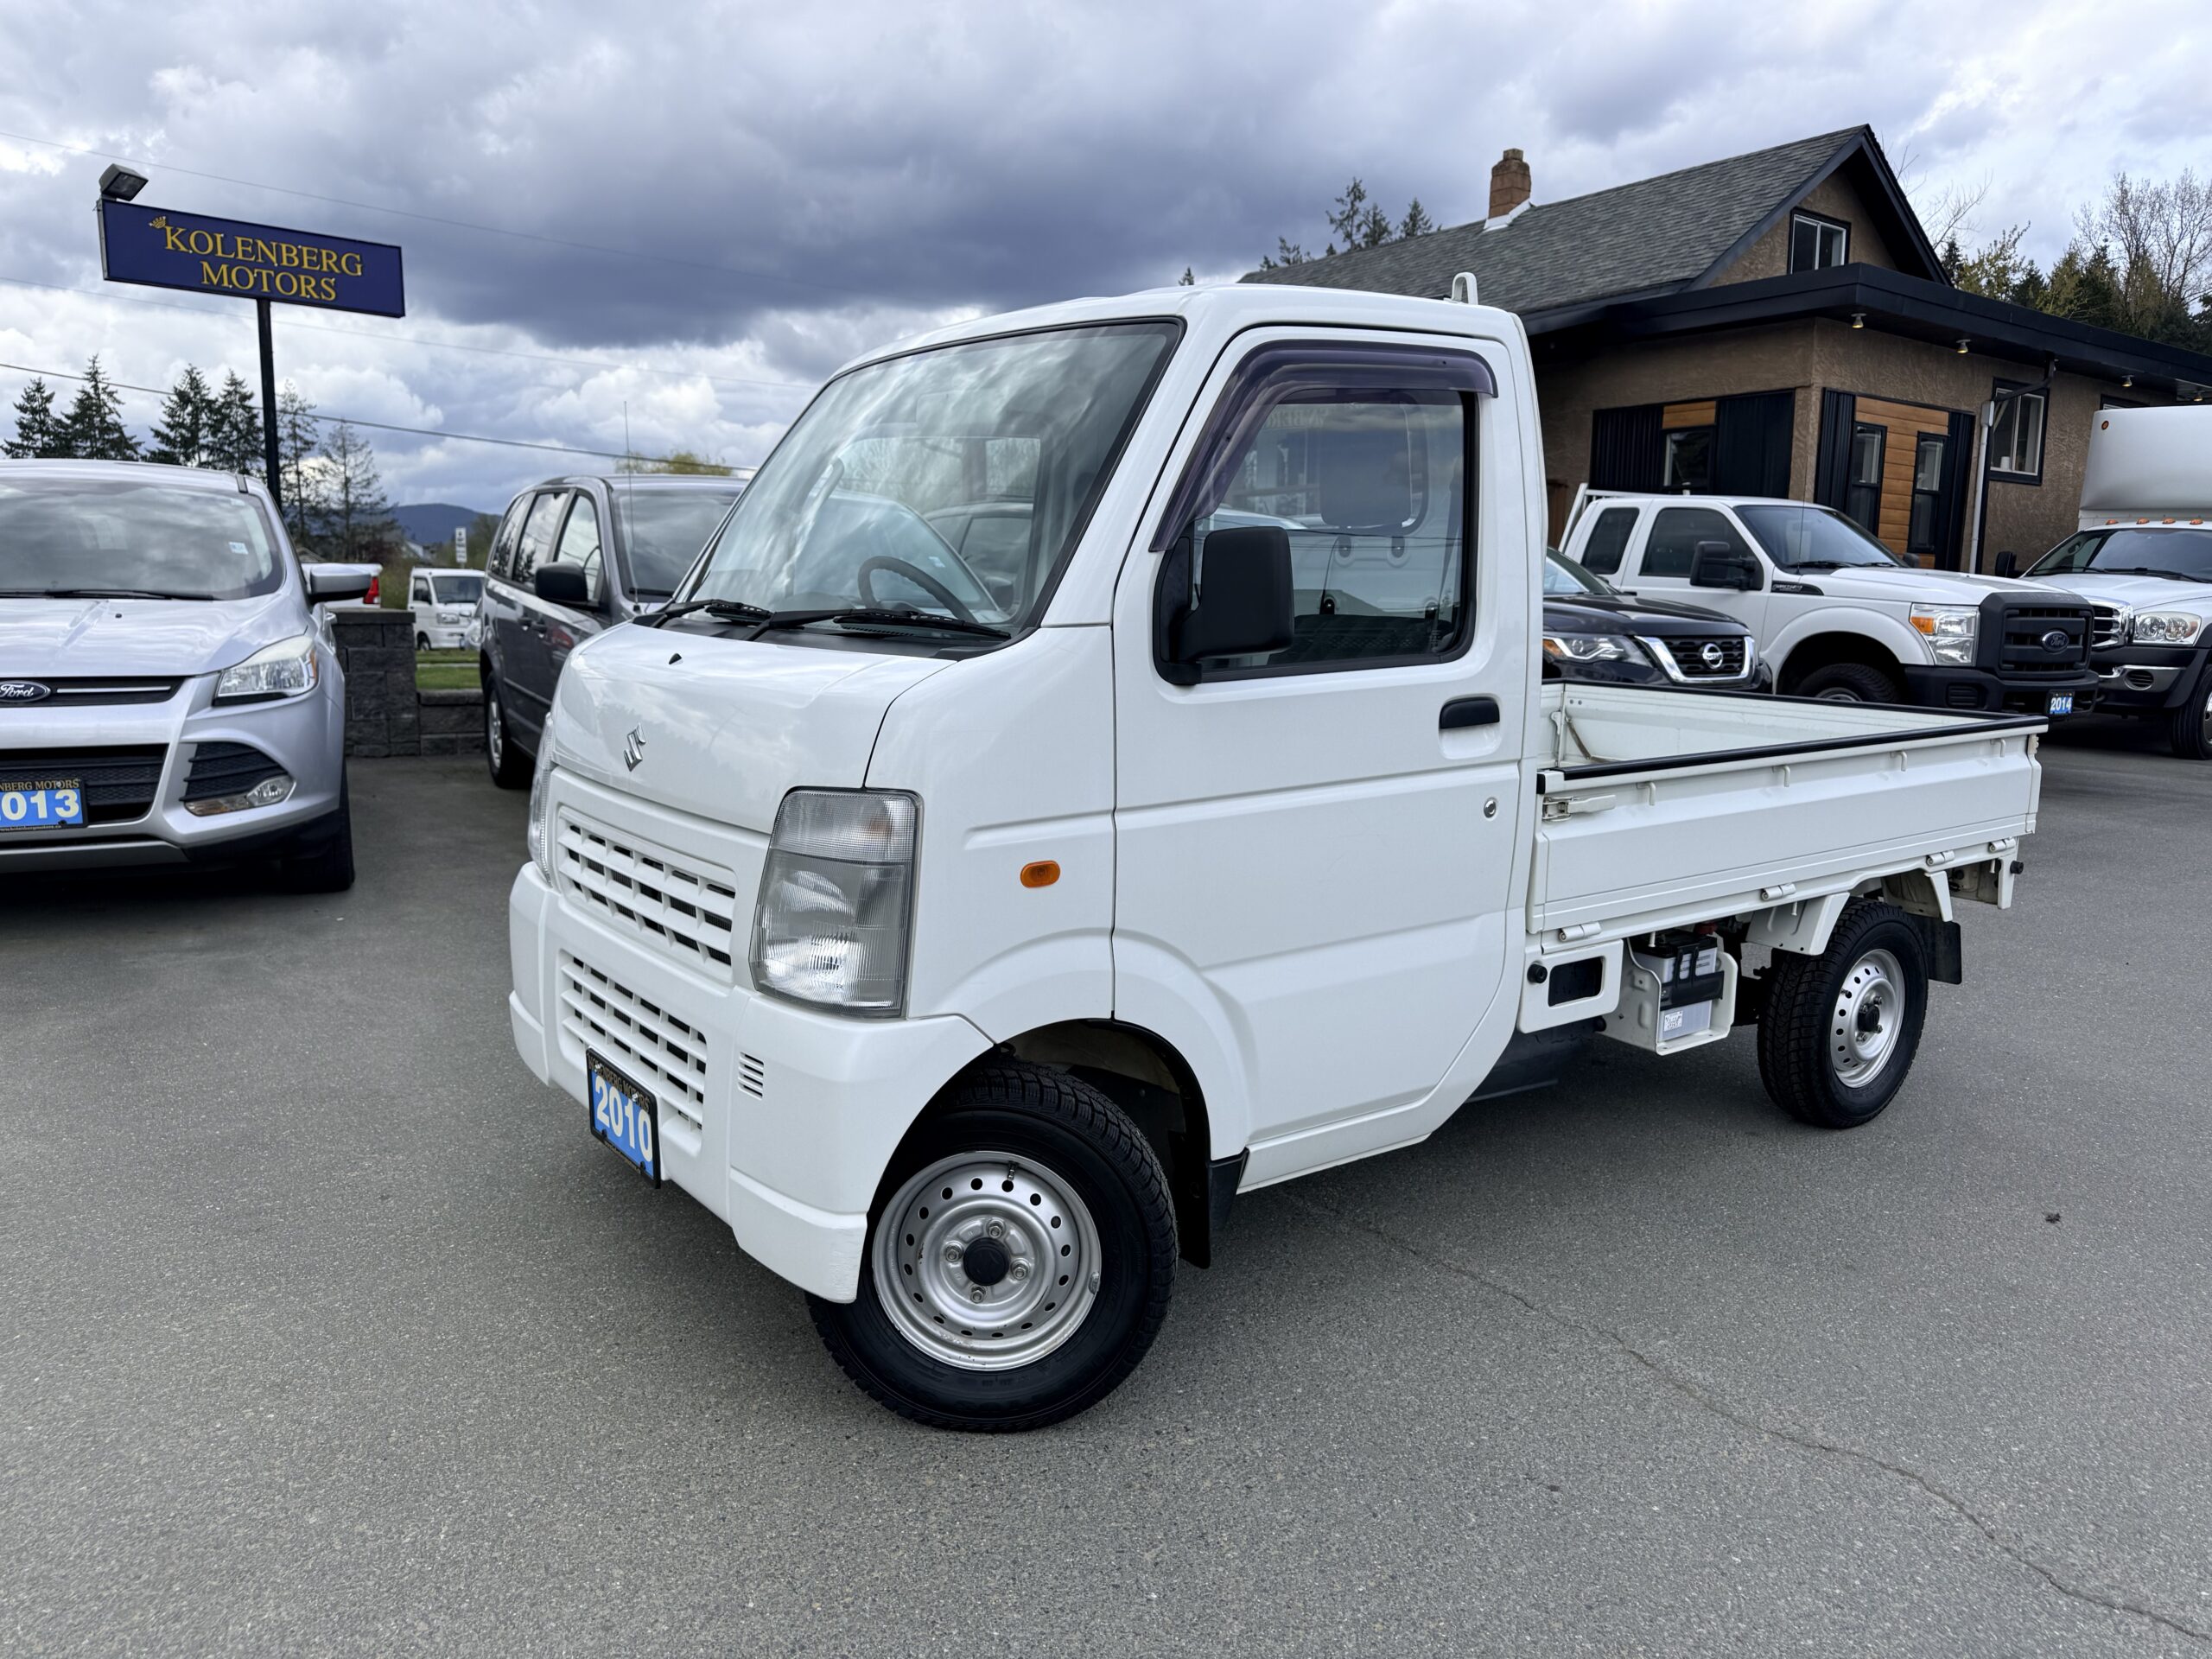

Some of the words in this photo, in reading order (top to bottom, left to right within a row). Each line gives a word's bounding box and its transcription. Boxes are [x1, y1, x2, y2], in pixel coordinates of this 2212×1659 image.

[164, 225, 363, 276] KOLENBERG
[200, 260, 336, 302] MOTORS
[0, 683, 34, 698] Ford
[2050, 696, 2073, 711] 2014
[0, 789, 79, 821] 013
[594, 1075, 653, 1162] 2010
